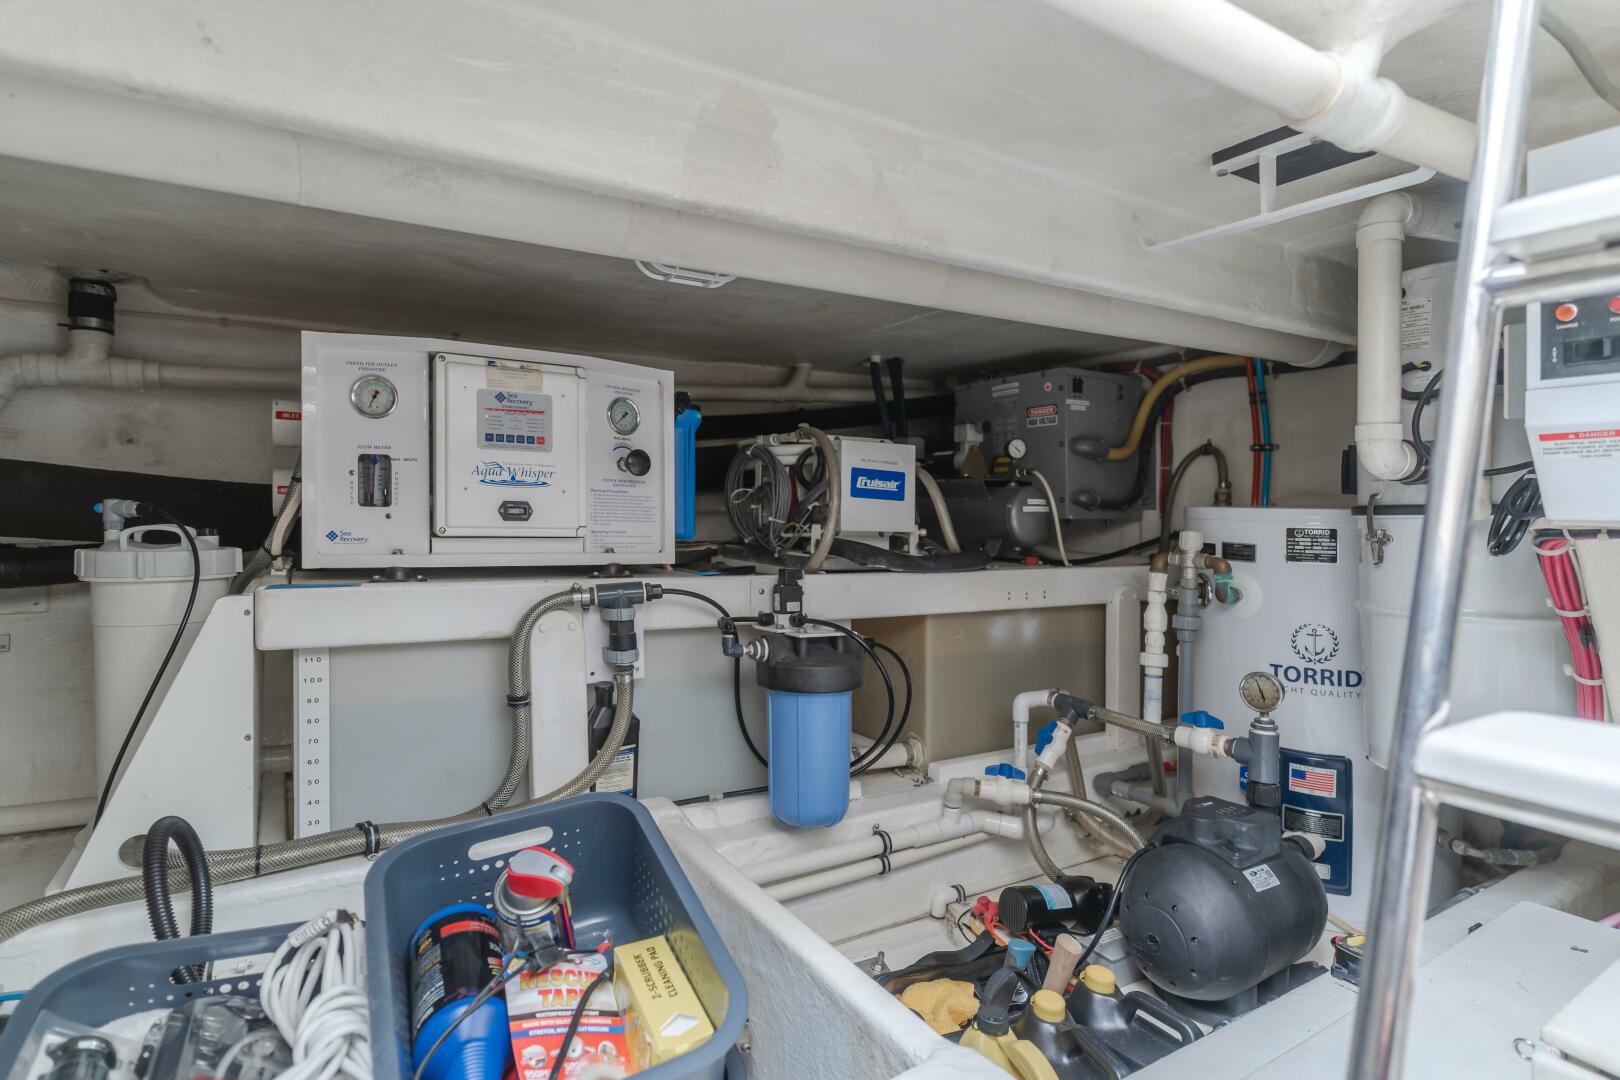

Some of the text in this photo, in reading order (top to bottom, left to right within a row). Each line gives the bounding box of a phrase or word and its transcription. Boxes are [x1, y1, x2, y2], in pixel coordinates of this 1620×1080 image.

[506, 398, 533, 406] Recovery
[1030, 406, 1055, 416] DANGER
[1028, 415, 1056, 426] HIGH VOLTAGE
[1579, 430, 1616, 439] DANGER
[471, 464, 556, 481] Aqua Whisper
[856, 476, 901, 491] Cruisair
[339, 536, 368, 544] Recovery
[1269, 663, 1363, 688] TORRID
[1310, 688, 1361, 699] QUALITY
[633, 953, 662, 1000] Z-SCRUBBER
[646, 946, 678, 998] CLEANING PAD
